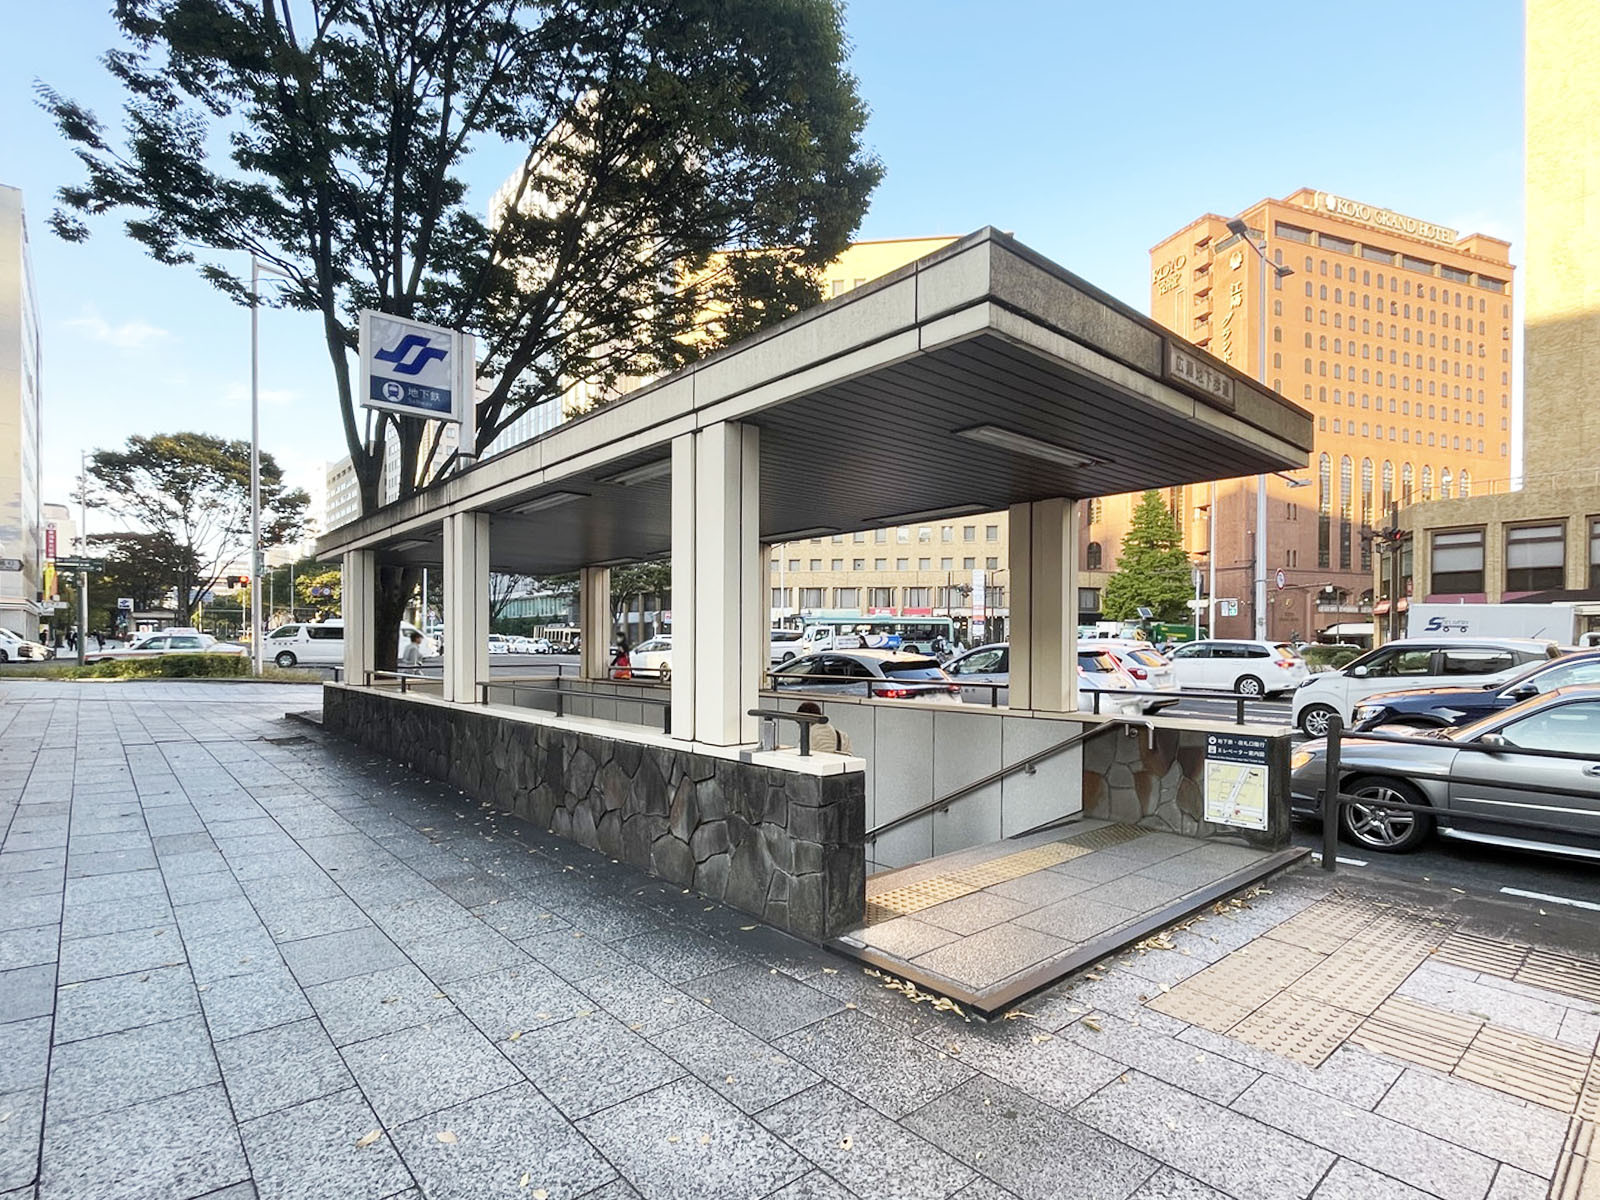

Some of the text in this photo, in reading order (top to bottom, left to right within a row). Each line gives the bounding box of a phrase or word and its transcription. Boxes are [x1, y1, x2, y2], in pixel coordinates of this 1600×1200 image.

[1374, 209, 1418, 234] GRAND
[1418, 223, 1456, 245] HOTEL
[407, 386, 441, 402] 地下鉄
